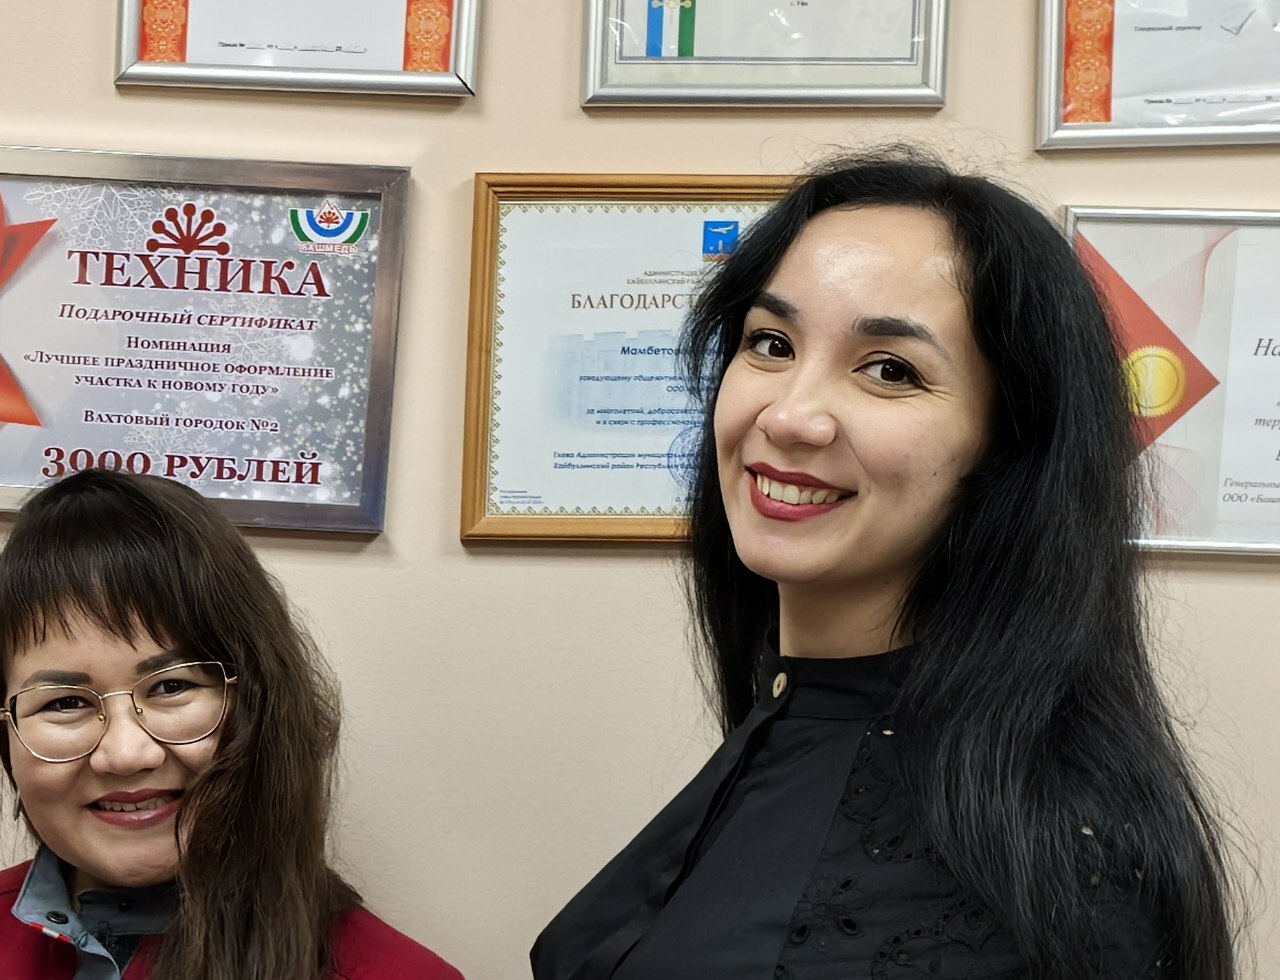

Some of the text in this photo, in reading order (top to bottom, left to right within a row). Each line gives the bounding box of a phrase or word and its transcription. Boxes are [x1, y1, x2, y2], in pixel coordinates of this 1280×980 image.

[67, 249, 332, 298] ТЕХНИКА
[58, 303, 318, 331] ПОДАРОЧНЫЙ СЕРТИФИКАТ
[126, 335, 231, 354] НОМИНАЦИЯ
[104, 357, 220, 373] ПРАЗДНИЧНОЕ
[224, 363, 334, 379] ОФОРМЛЕНИЕ
[74, 374, 142, 389] УЧАСТКА
[147, 378, 158, 389] К
[161, 380, 226, 394] НОВОМУ
[83, 410, 280, 433] ВАХТОВЫЙ ГОРОДОК №2
[41, 446, 323, 485] 3000 РУБЛЕЙ
